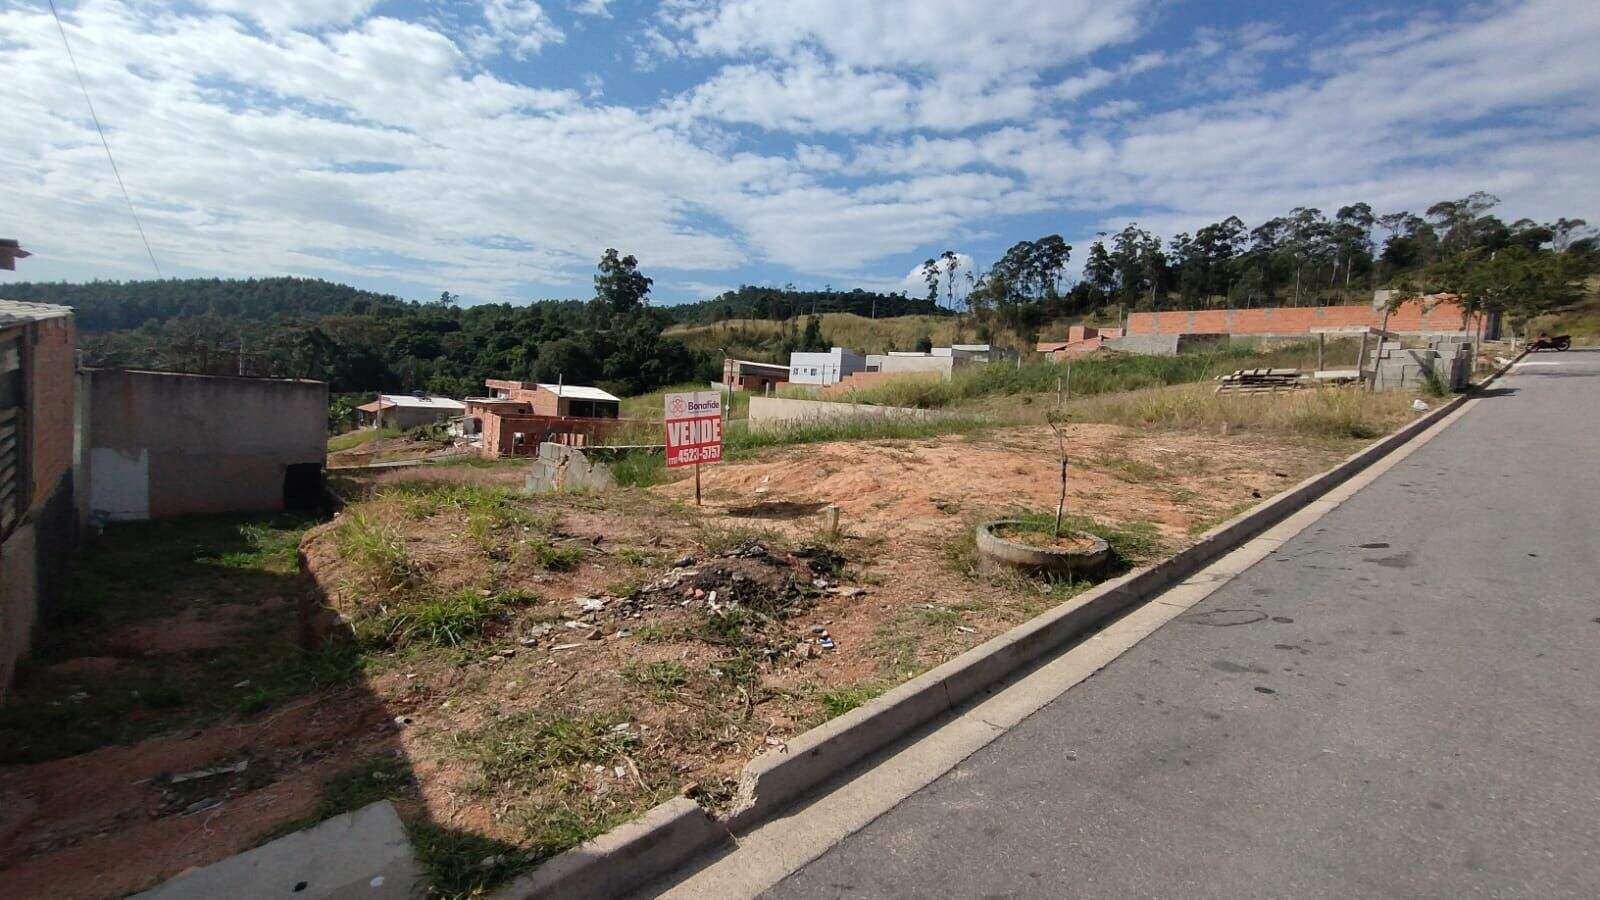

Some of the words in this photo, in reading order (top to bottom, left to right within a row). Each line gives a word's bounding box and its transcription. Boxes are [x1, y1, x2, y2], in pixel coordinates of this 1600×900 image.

[688, 400, 719, 410] Bonafide
[668, 418, 721, 447] VENDE
[678, 445, 720, 463] 4523-5757
